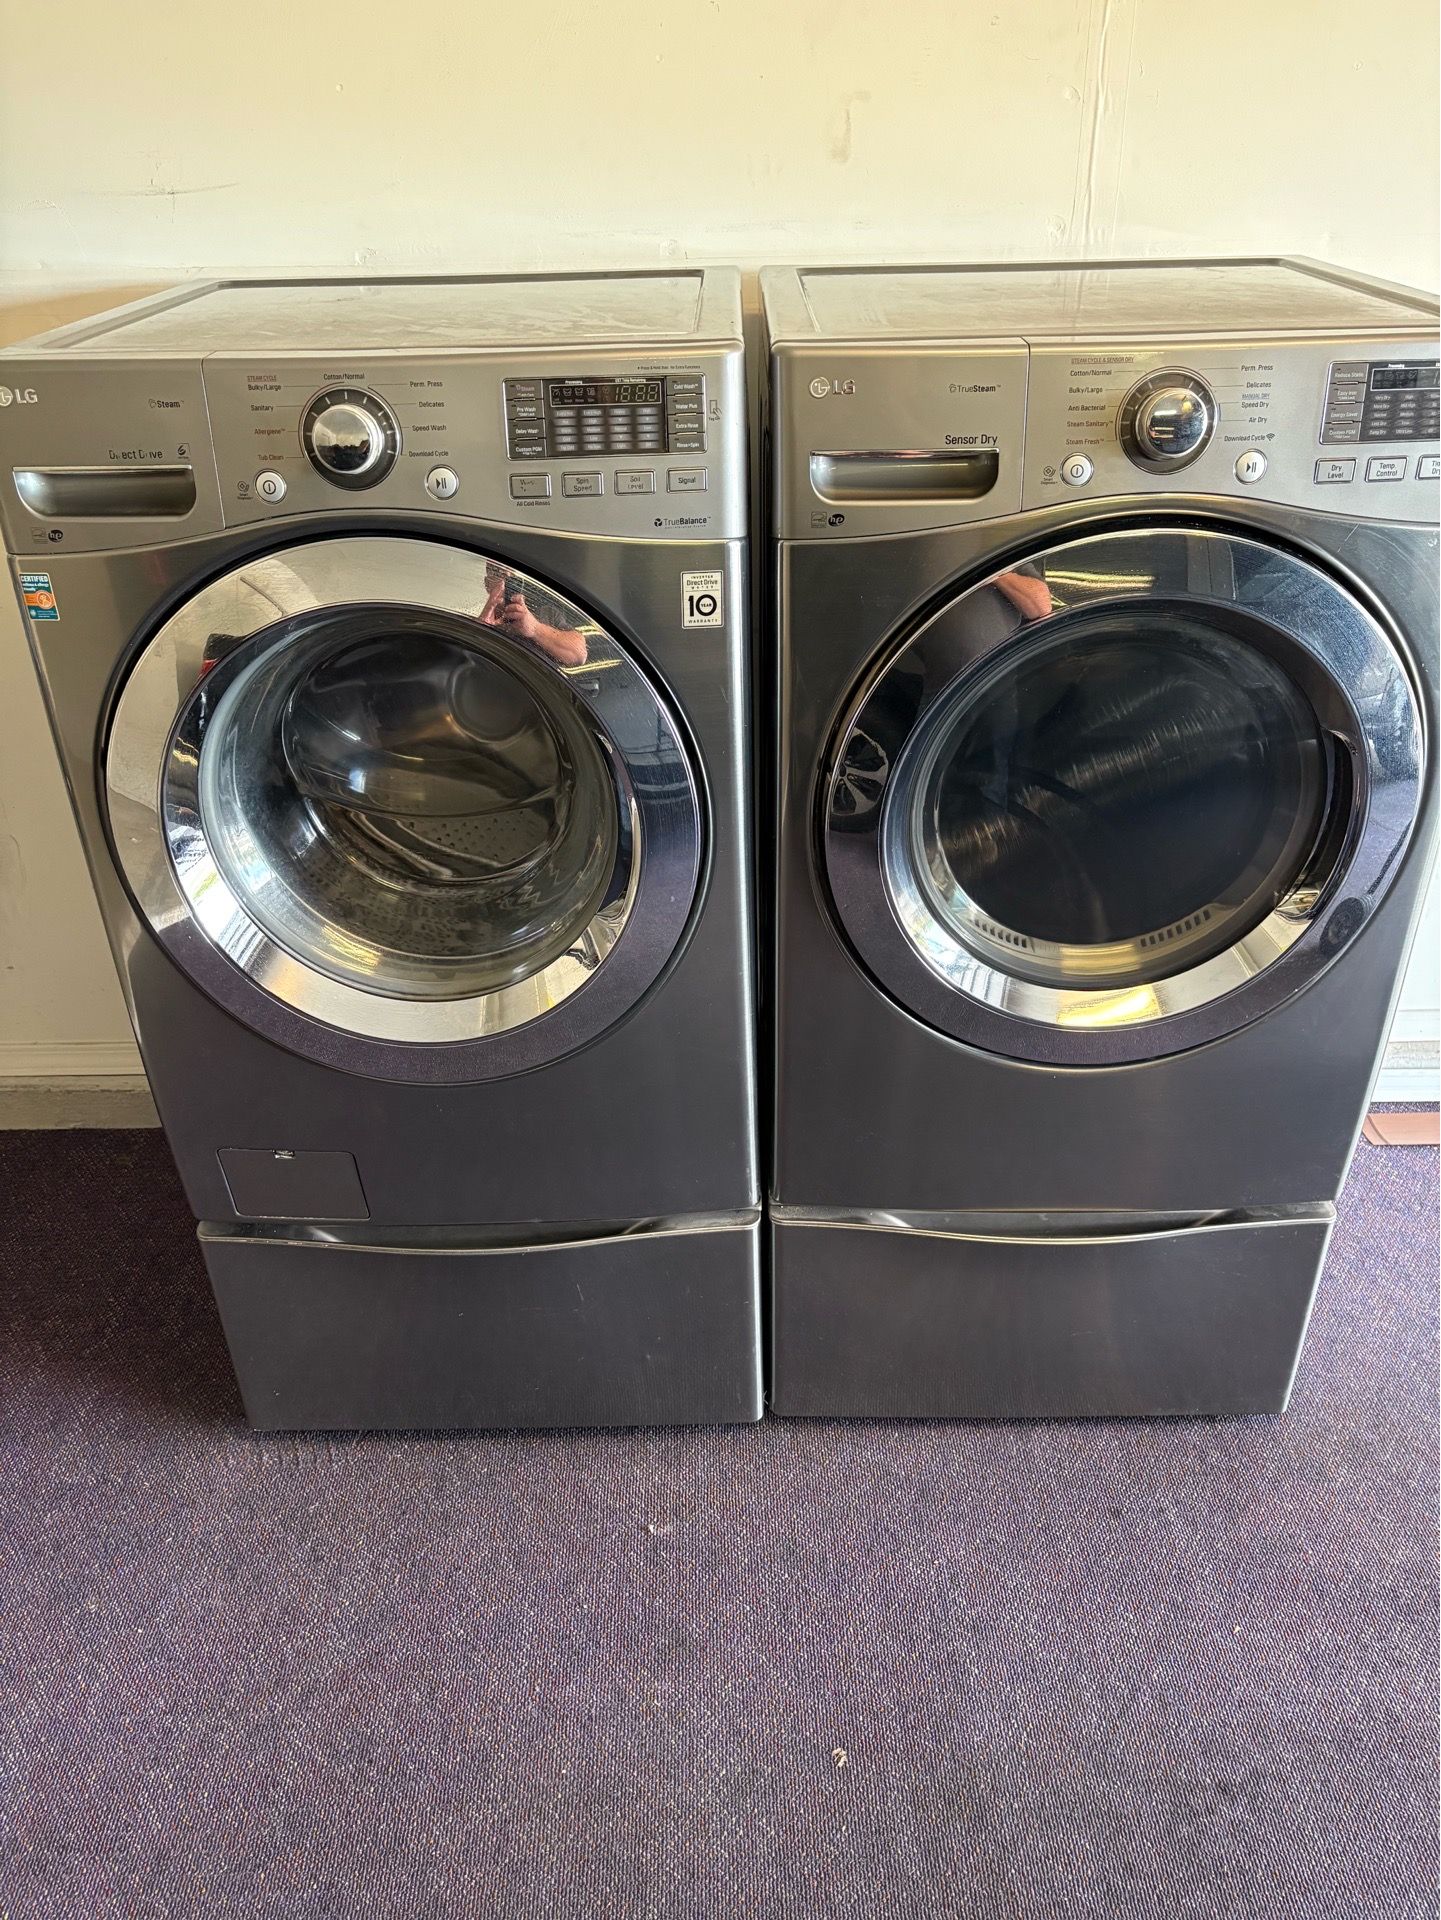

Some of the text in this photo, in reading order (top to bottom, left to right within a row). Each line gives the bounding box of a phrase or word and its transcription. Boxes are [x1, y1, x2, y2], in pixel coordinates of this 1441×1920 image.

[323, 373, 365, 381] Cotton/Normal
[833, 379, 856, 395] LG
[15, 388, 38, 404] LG
[251, 404, 274, 412] Sanitary
[945, 434, 998, 446] Sensor Dry
[688, 594, 717, 616] 10
